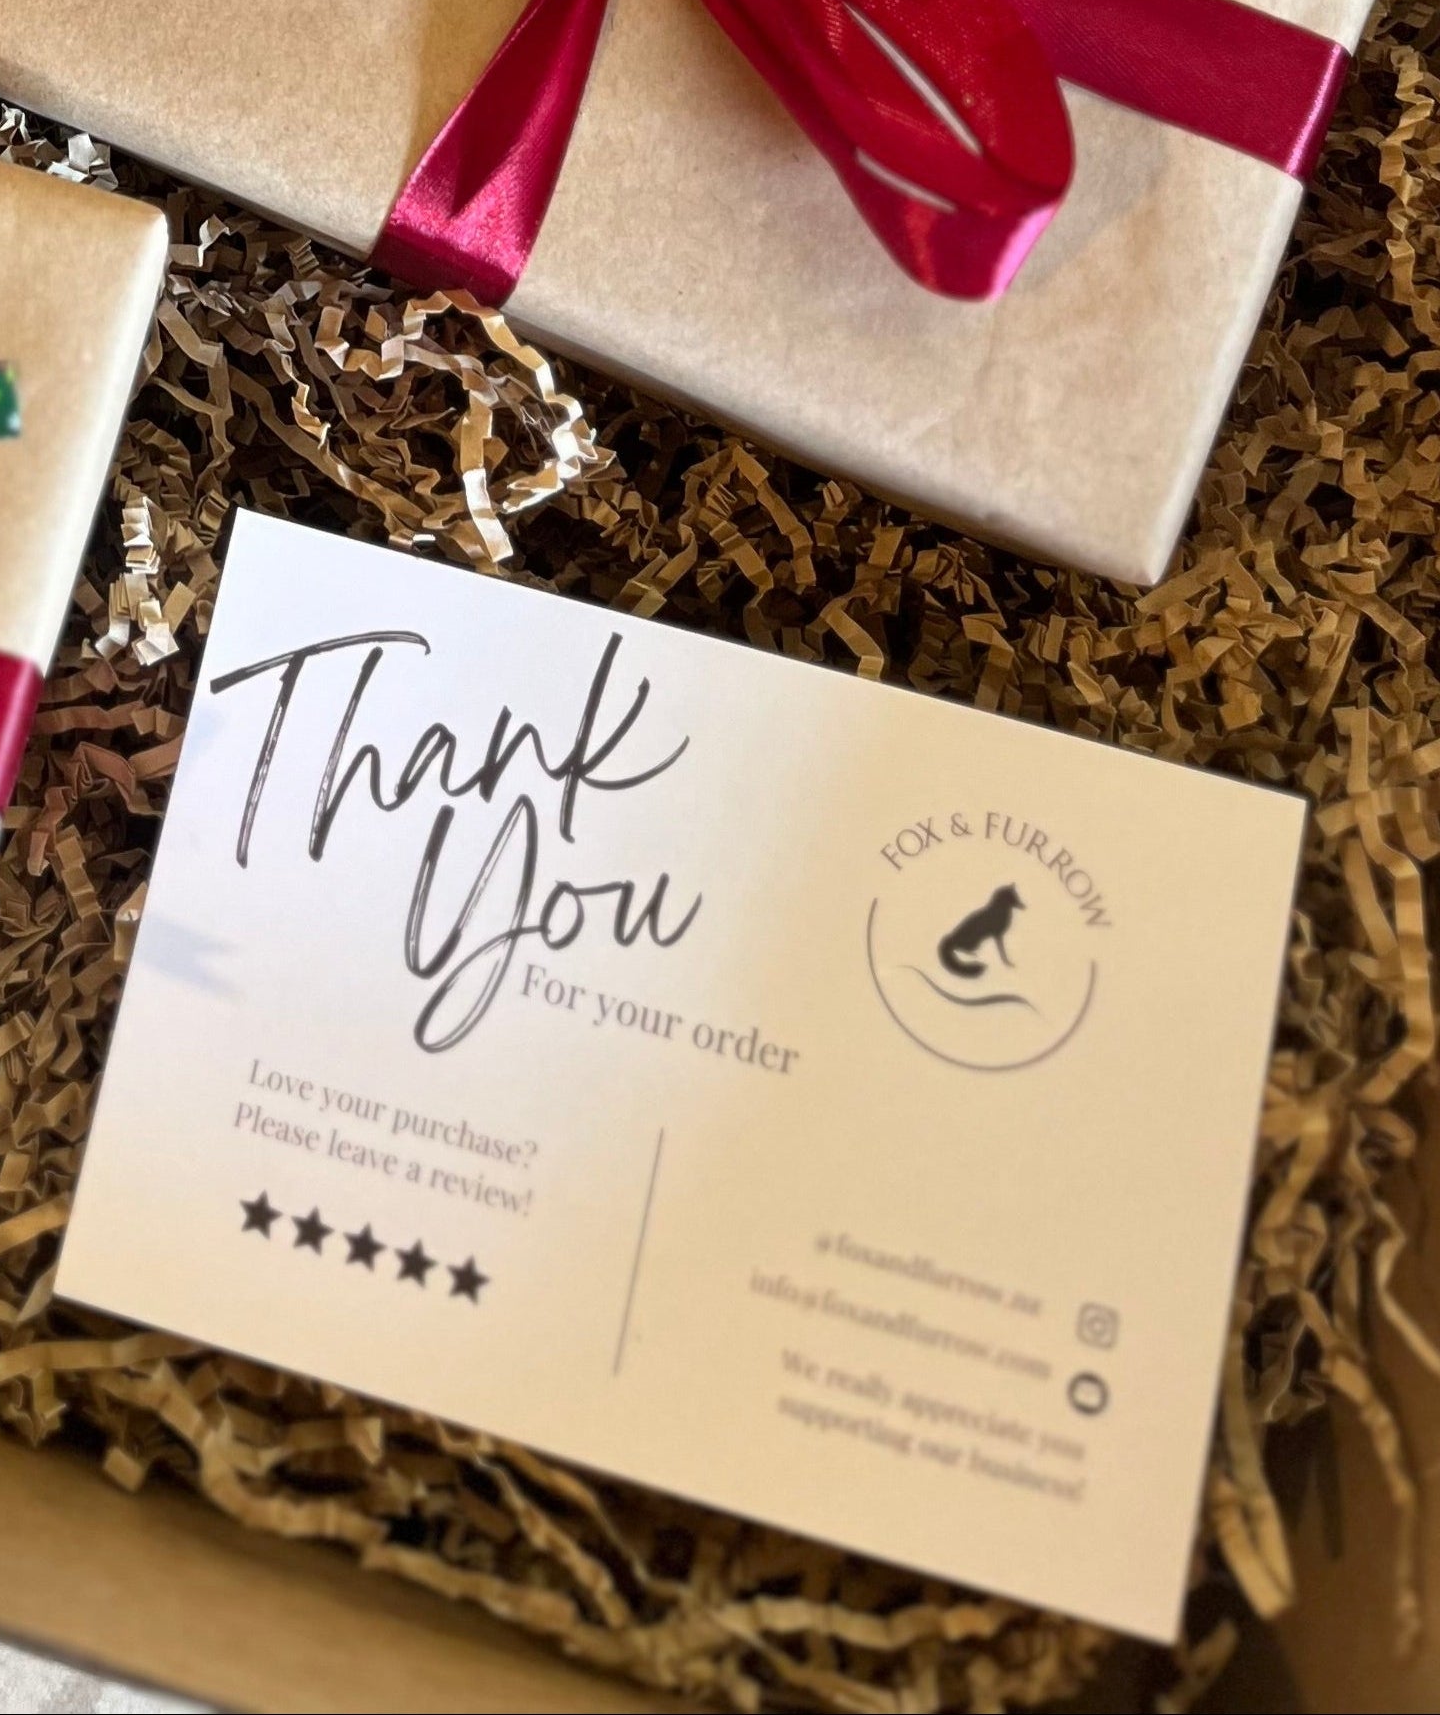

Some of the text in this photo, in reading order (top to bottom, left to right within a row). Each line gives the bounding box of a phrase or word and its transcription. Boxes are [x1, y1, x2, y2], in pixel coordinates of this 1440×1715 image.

[210, 630, 690, 869] Thank
[404, 793, 703, 1054] You
[880, 811, 1114, 928] FOX & FURROW
[519, 962, 801, 1076] For your order
[233, 1101, 534, 1217] Please leave a review!
[249, 1059, 539, 1169] Love your purchase?
[777, 1396, 914, 1457] supporting
[917, 1439, 963, 1468] our
[780, 1347, 1086, 1462] We really appreciate you
